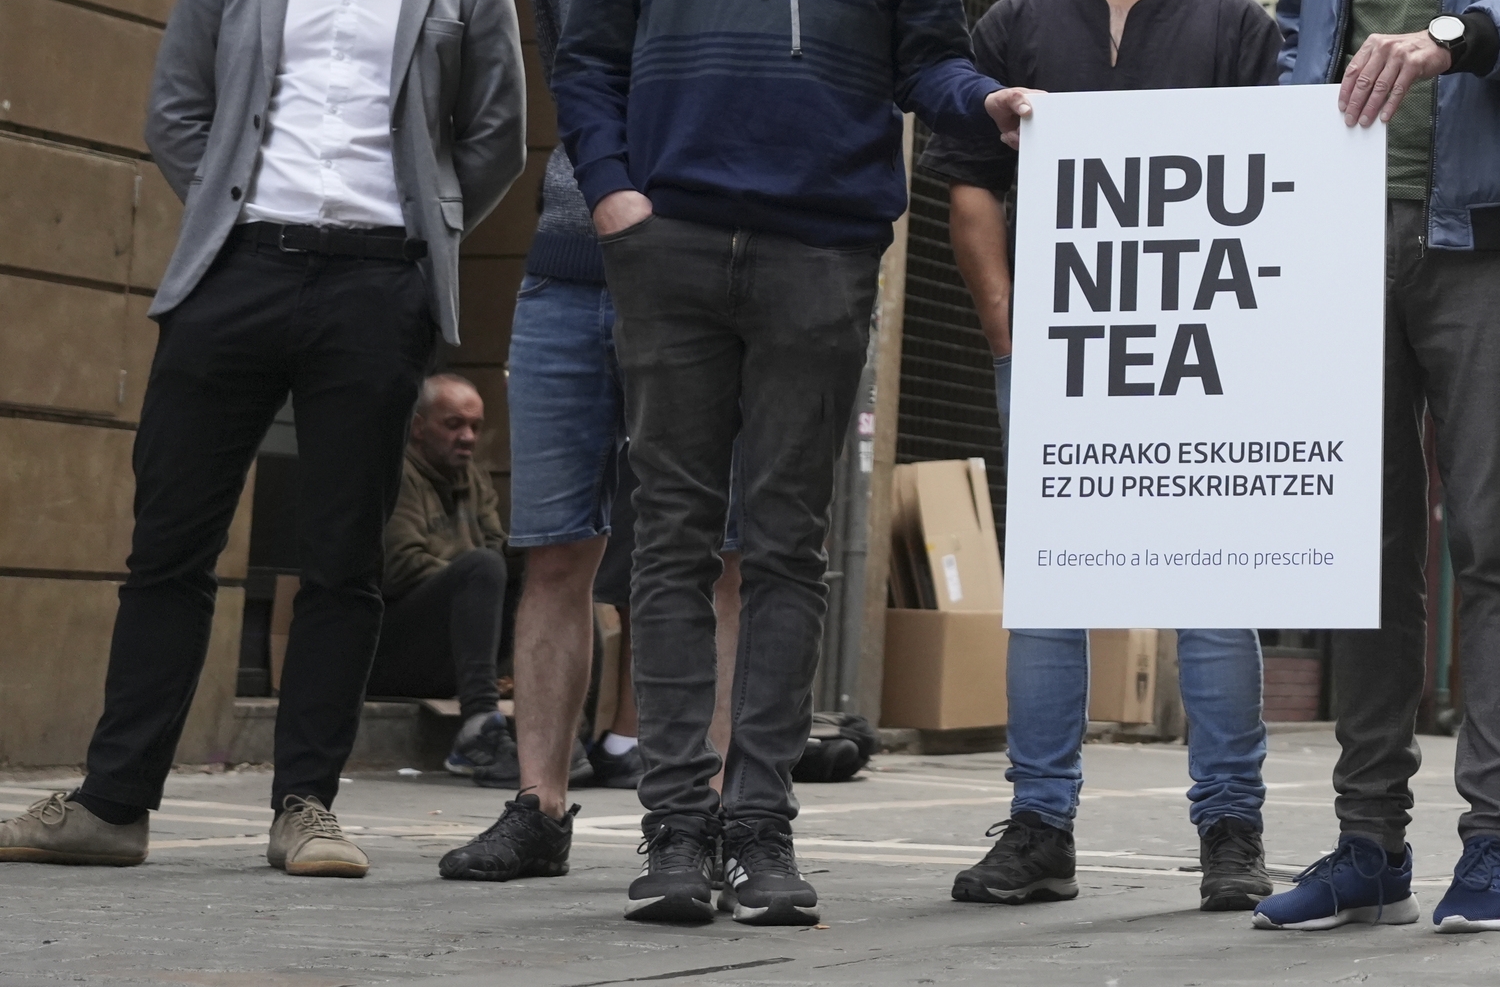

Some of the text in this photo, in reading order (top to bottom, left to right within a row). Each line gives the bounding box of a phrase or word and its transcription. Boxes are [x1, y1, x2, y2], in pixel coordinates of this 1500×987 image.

[1055, 153, 1295, 230] INPU-
[1052, 237, 1282, 314] NITA-
[1047, 322, 1224, 398] TEA
[1042, 440, 1345, 466] EGIARAKO ESKUBIDEAK
[1041, 473, 1334, 499] EZ DU PRESKRIBATZEN
[1037, 547, 1335, 570] El derecho a la verdad no prescribe
